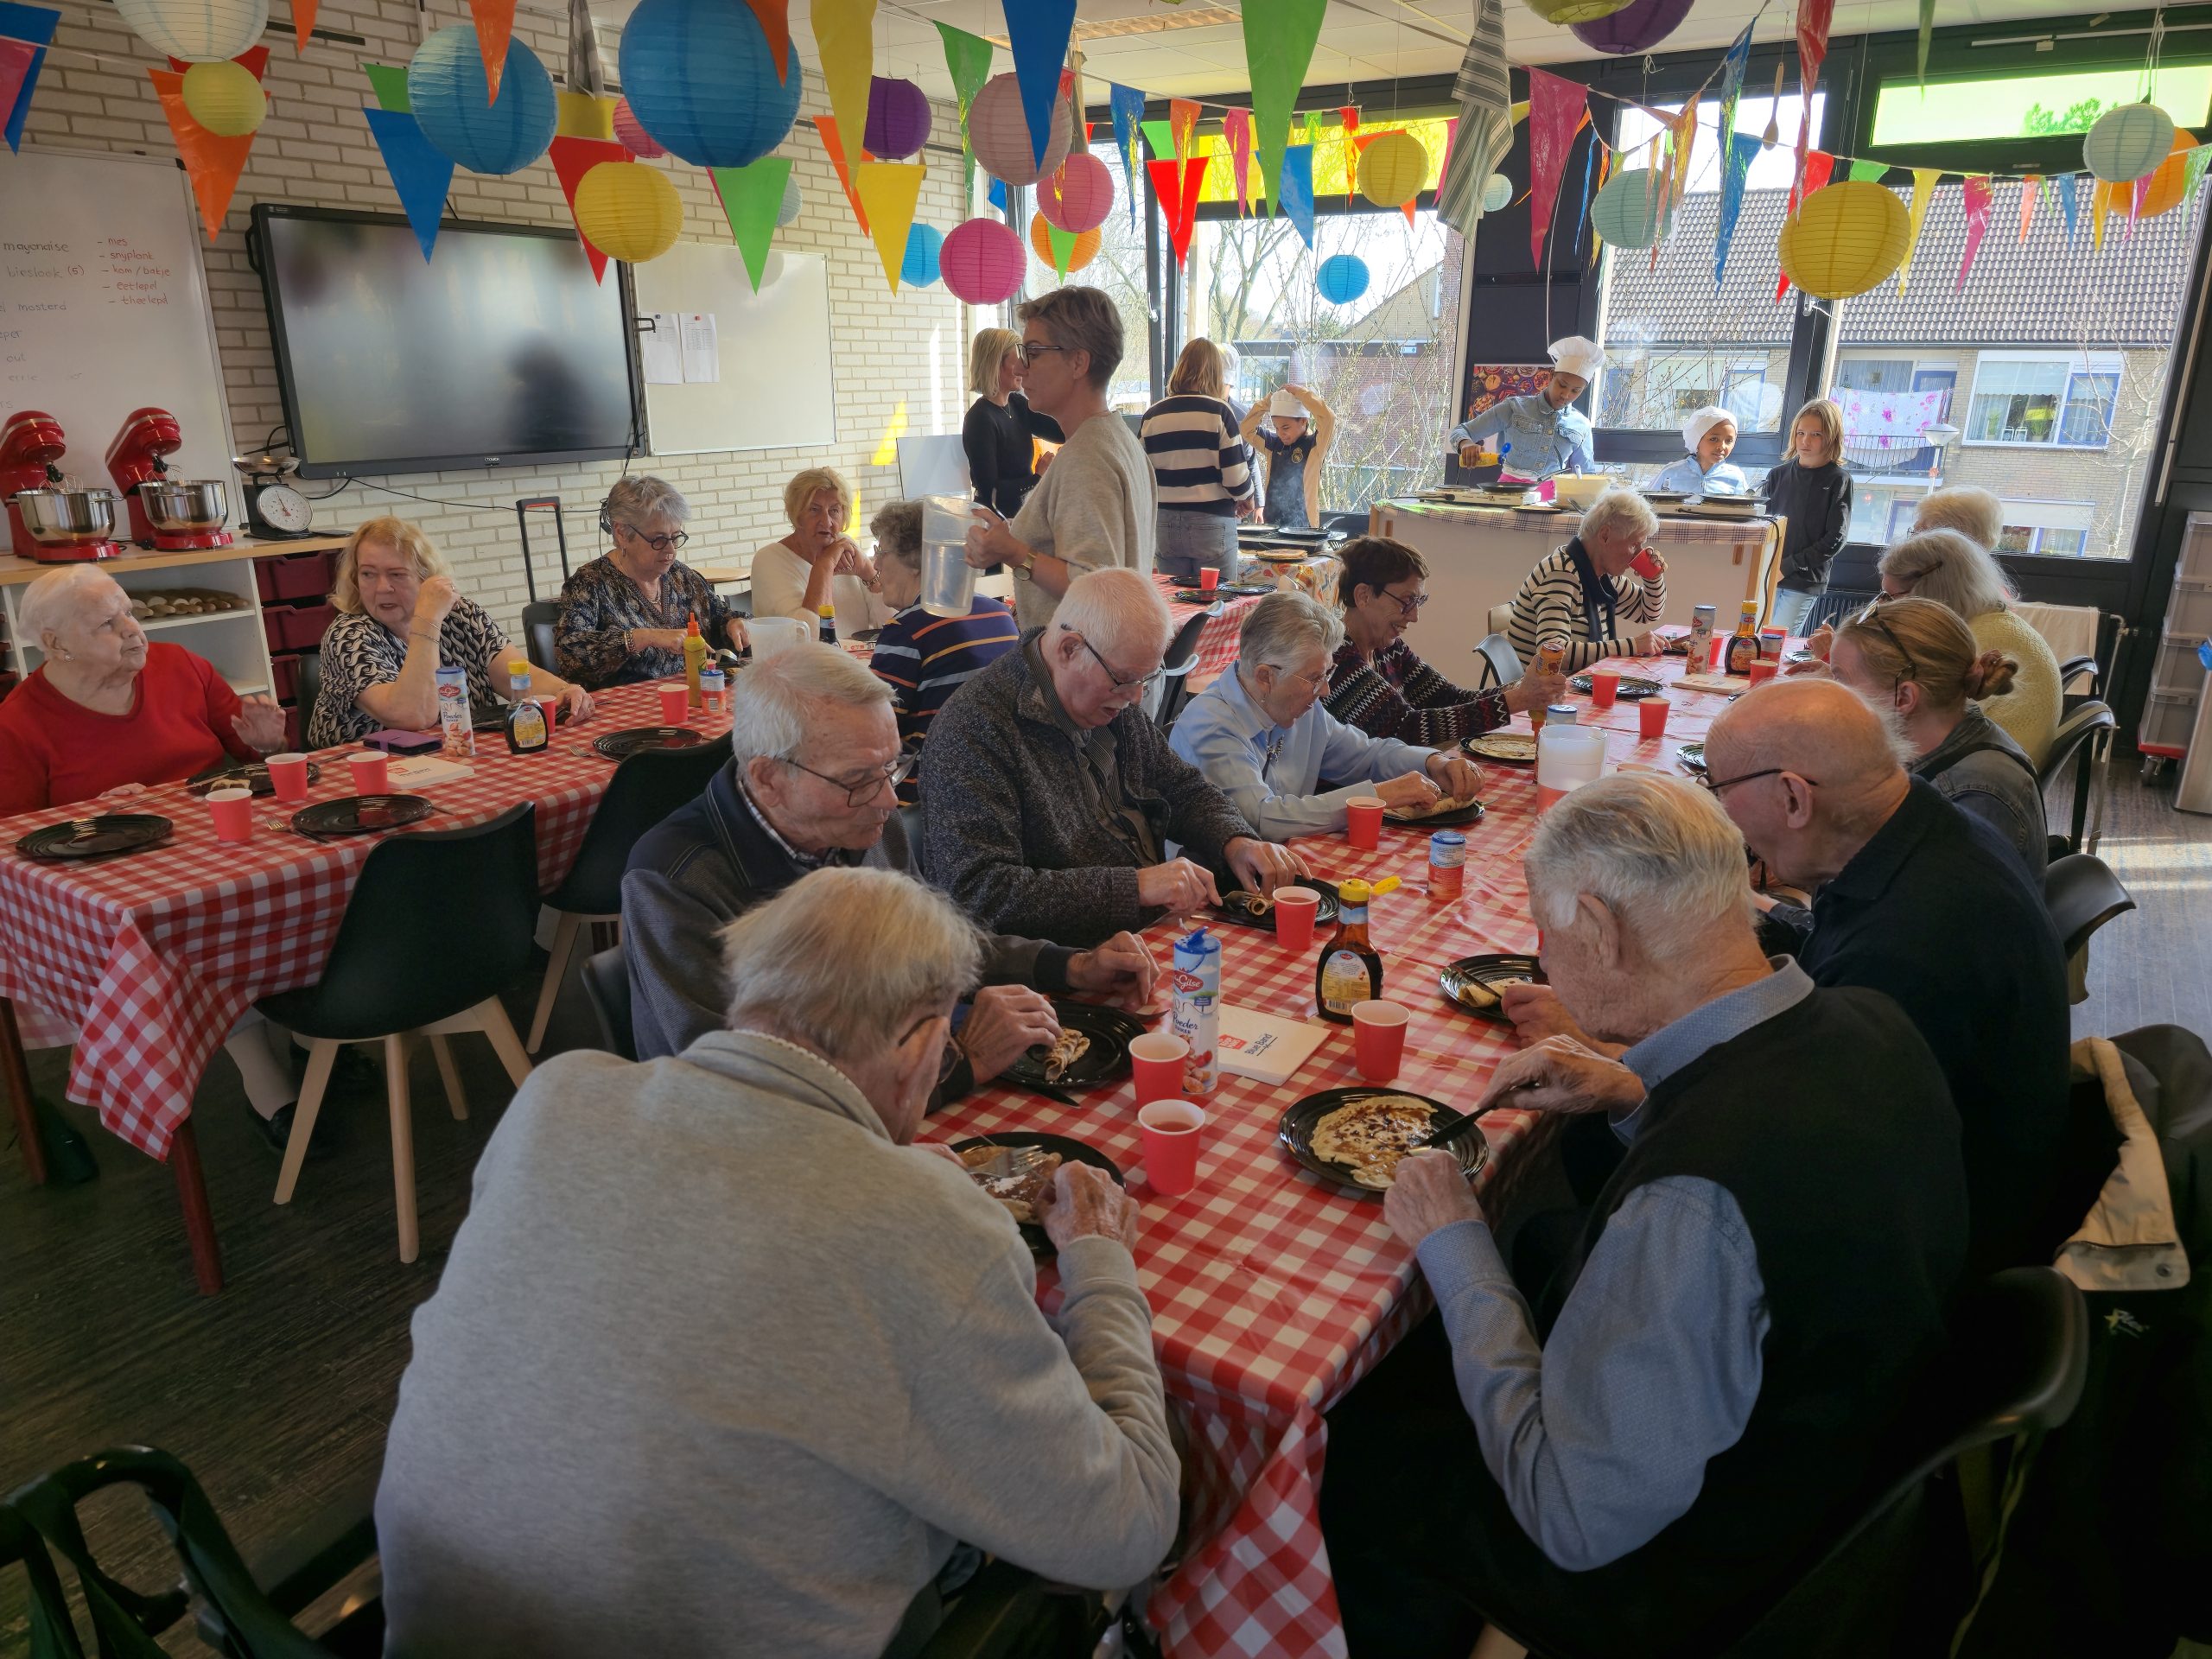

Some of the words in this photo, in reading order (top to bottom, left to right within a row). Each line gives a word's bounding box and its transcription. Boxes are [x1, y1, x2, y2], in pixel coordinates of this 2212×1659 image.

[3, 240, 70, 254] mayonaise
[108, 237, 128, 246] mes
[67, 264, 85, 276] (5)
[111, 264, 132, 275] kom
[143, 265, 170, 277] bakje
[17, 300, 67, 311] mosterd
[1179, 974, 1201, 990] Gilse
[1173, 1010, 1198, 1030] Poeder
